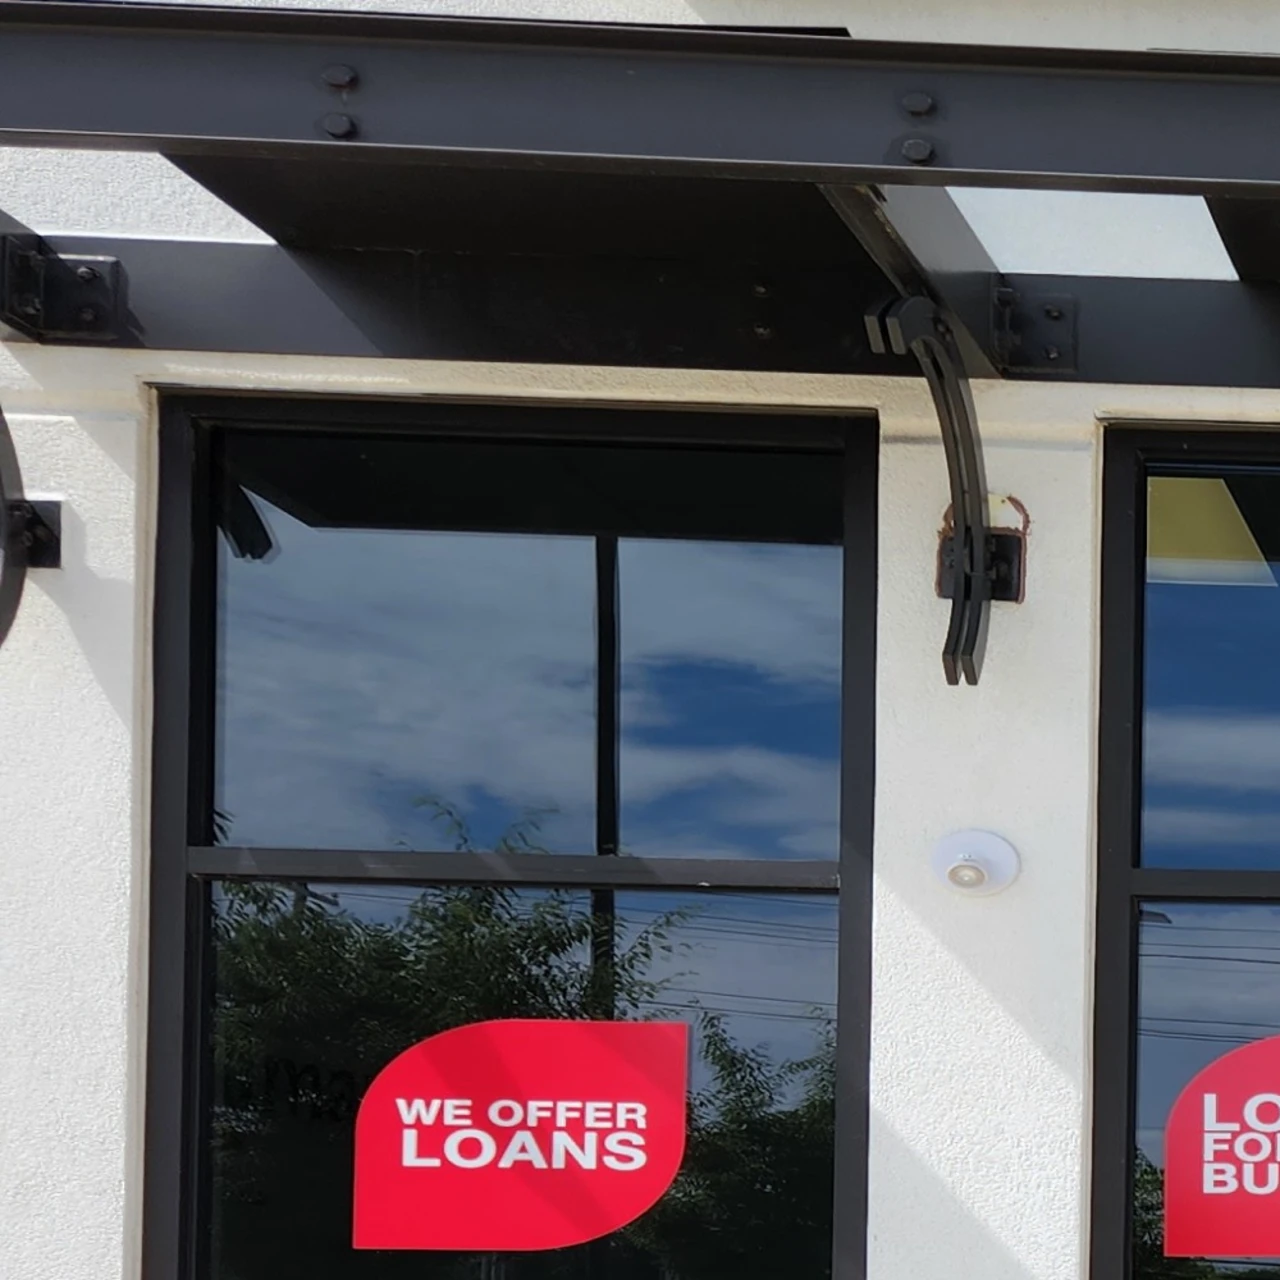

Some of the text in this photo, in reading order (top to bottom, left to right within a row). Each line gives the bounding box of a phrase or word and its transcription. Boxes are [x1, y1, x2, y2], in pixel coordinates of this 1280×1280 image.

[395, 1098, 647, 1129] WE OFFER
[402, 1128, 647, 1171] LOANS
